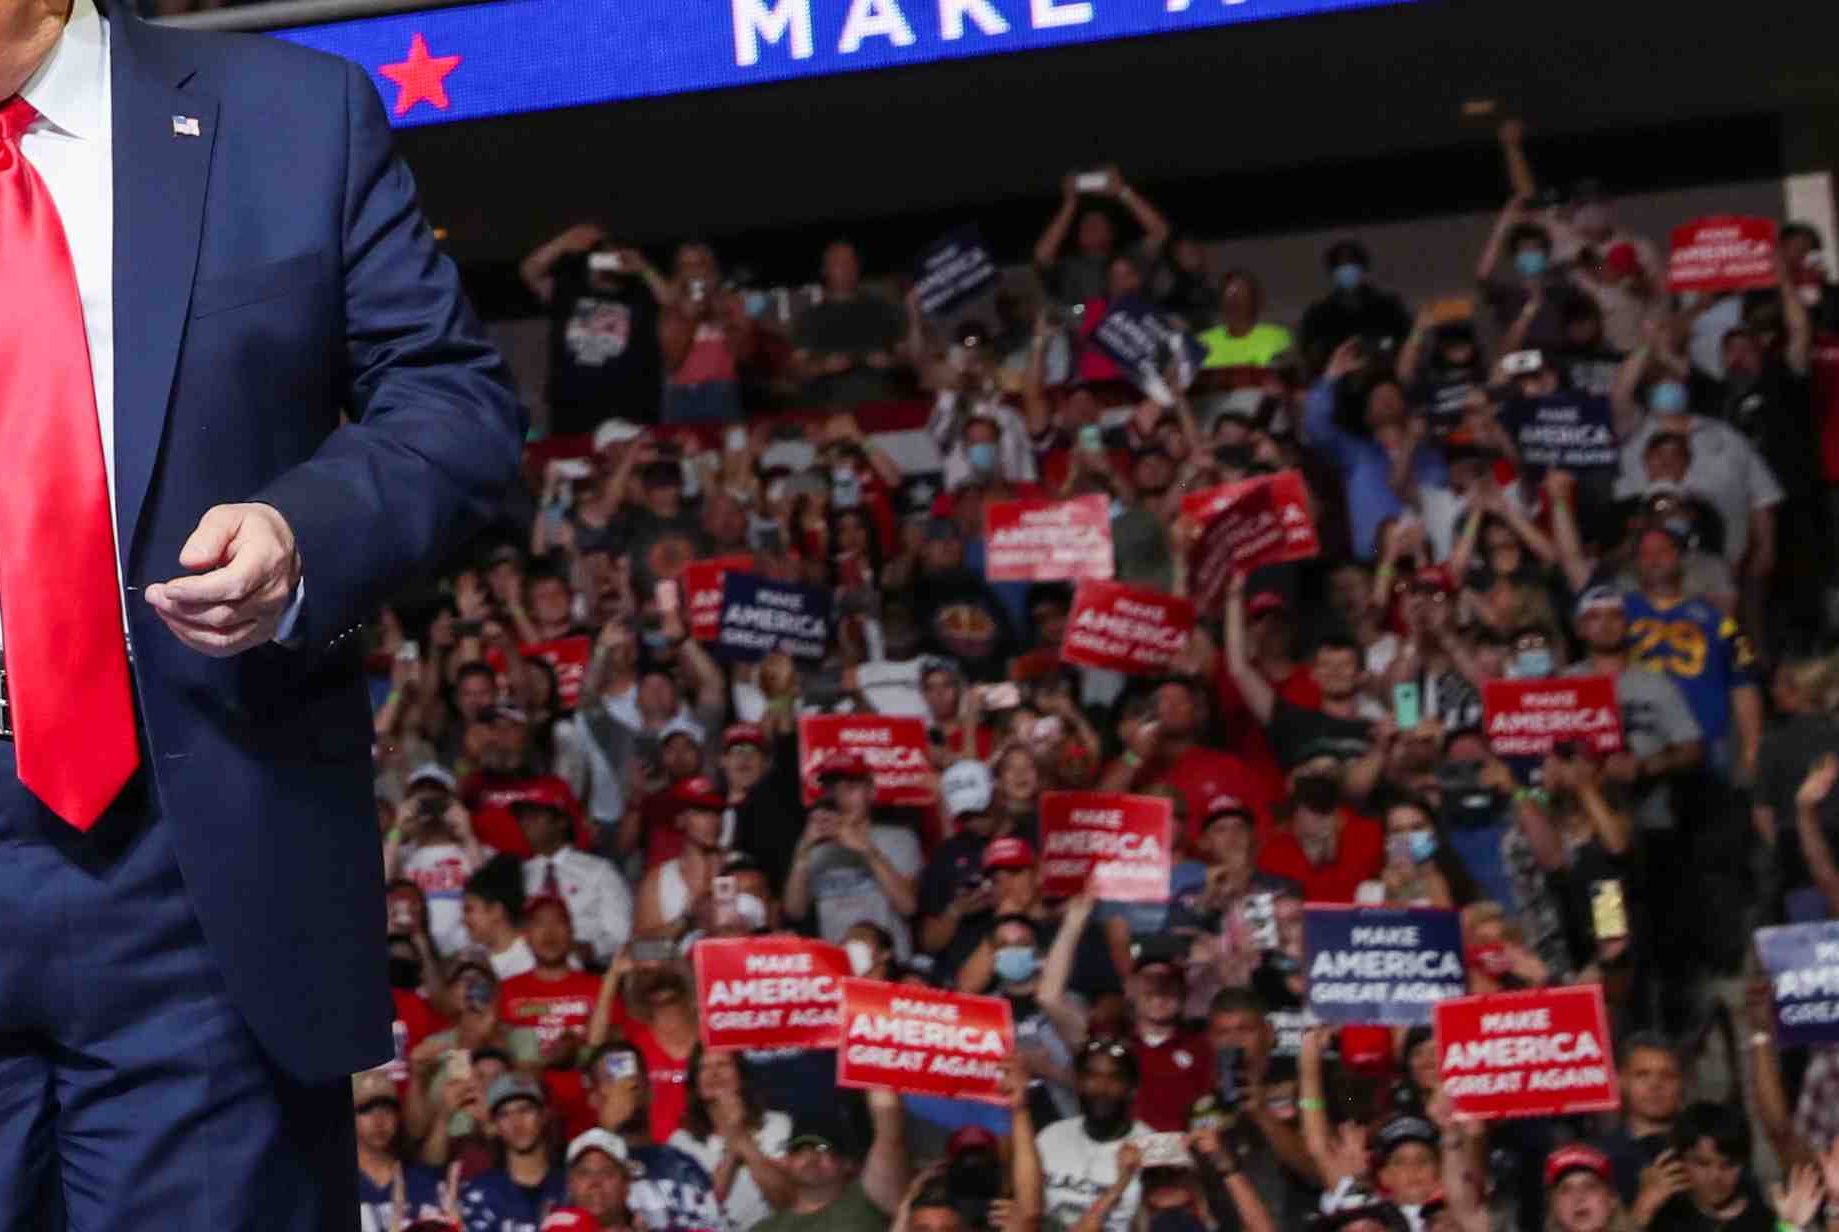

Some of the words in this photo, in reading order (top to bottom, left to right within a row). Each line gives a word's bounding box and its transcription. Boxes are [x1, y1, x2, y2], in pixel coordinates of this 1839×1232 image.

[724, 603, 827, 638] AMERICA
[1076, 607, 1187, 650] AMERICA
[1489, 707, 1619, 735] AMERICA
[839, 727, 893, 746] MAKE
[1070, 809, 1123, 828] MAKE
[1046, 830, 1161, 861] AMERICA
[1350, 925, 1421, 946] MAKE
[745, 953, 814, 975] MAKE
[1309, 949, 1464, 980] AMERICA
[1309, 981, 1390, 1004] GREAT
[708, 1009, 784, 1032] GREAT
[889, 997, 961, 1022] MAKE
[1479, 1008, 1551, 1035] MAKE
[848, 1013, 1006, 1055] AMERICA
[847, 1044, 928, 1072] GREAT
[1441, 1031, 1603, 1072] AMERICA
[1443, 1072, 1523, 1099] GREAT
[1526, 1066, 1609, 1093] AGAIN
